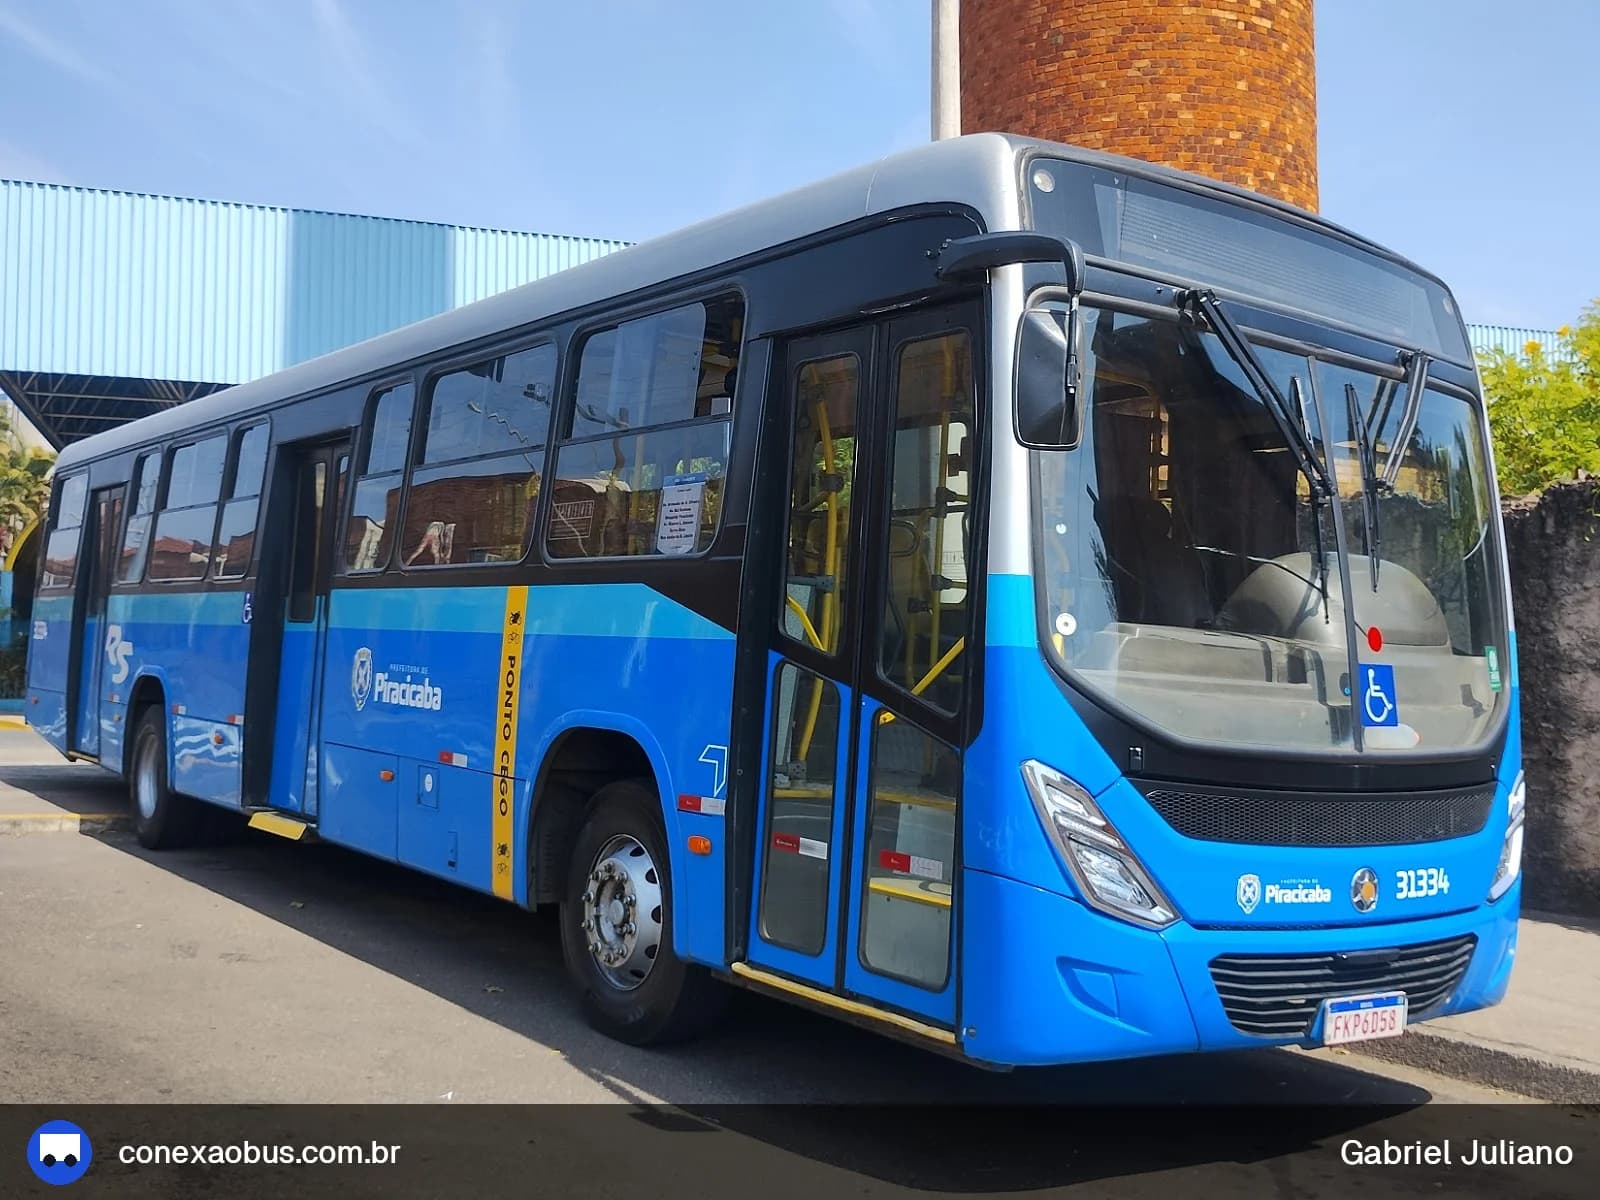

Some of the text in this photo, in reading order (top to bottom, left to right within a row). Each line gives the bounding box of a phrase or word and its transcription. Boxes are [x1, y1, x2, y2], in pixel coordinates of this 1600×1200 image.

[374, 672, 442, 711] Piracicaba
[499, 655, 516, 817] PONTO CEGO
[1264, 884, 1332, 904] Piracicaba
[1395, 867, 1450, 899] 31334
[1333, 1009, 1396, 1039] FKP6D58
